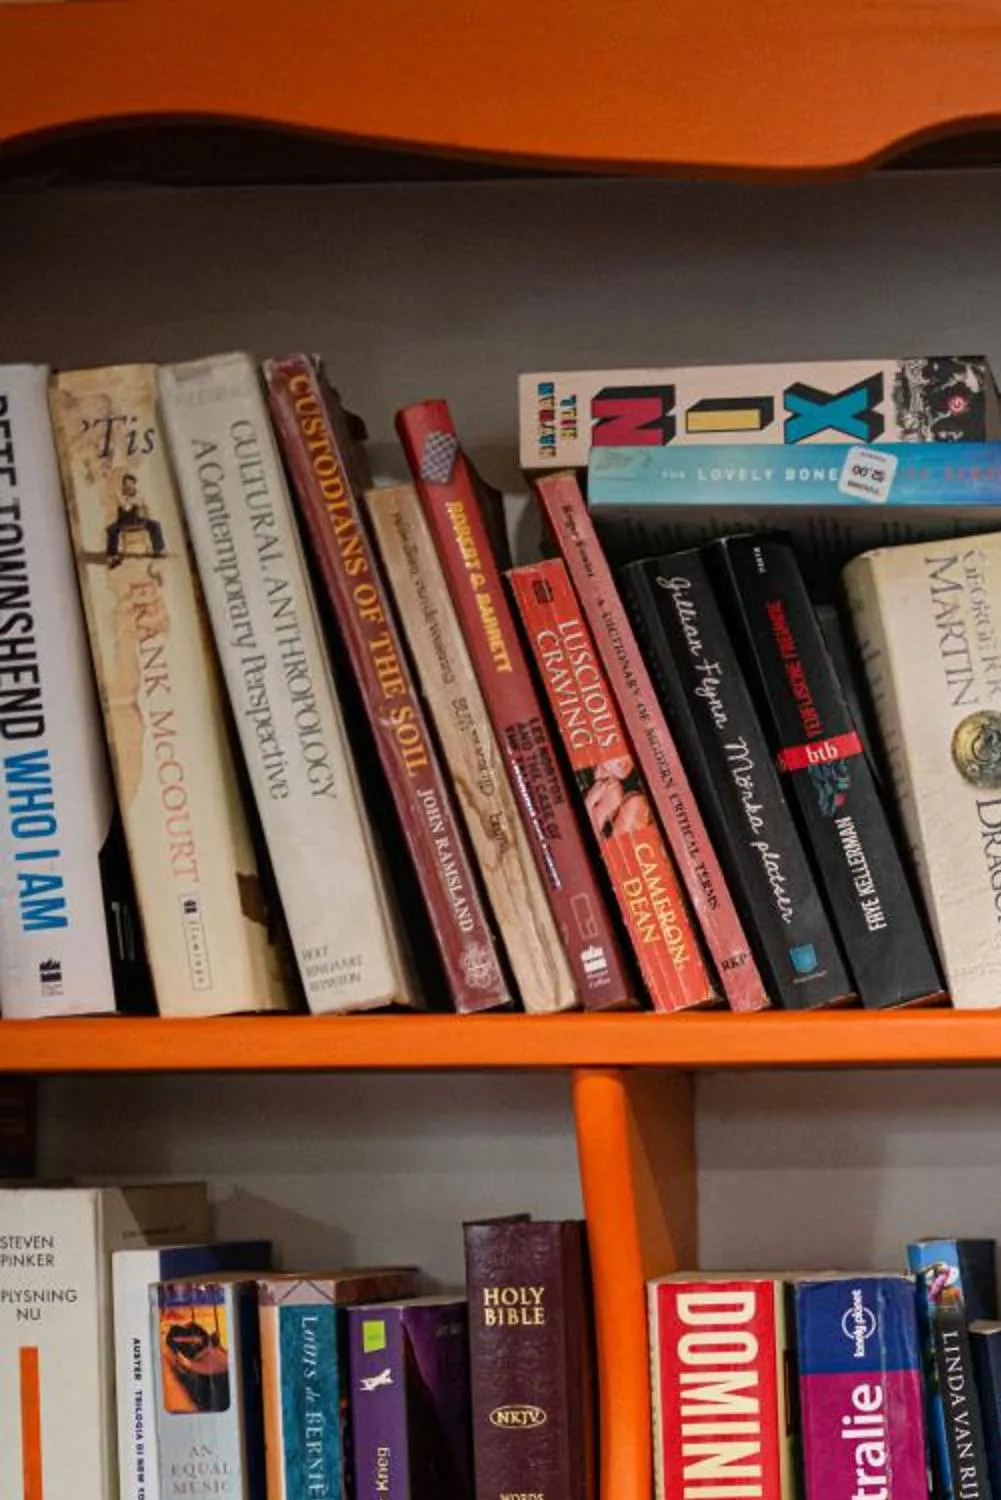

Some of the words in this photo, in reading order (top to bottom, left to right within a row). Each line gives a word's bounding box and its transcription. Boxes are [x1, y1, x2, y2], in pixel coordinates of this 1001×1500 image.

[191, 439, 218, 459] A
[697, 467, 773, 483] LOVELY
[199, 462, 256, 648] Contemporary
[288, 375, 369, 577] CUSTODIANS
[354, 583, 381, 625] OF
[368, 632, 405, 698] THE
[390, 703, 428, 778] SOIL
[129, 580, 170, 697] FRANK
[230, 420, 283, 570] CULTURAL
[266, 577, 337, 799] ANTHROPOLOGY
[925, 555, 979, 706] MARTIN
[241, 653, 289, 800] Perspective
[537, 631, 592, 750] CRAVING
[558, 619, 618, 747] LUSCIOUS
[3, 749, 57, 839] WHO
[693, 659, 729, 729] Flynn
[752, 840, 792, 924] platser
[805, 742, 839, 764] btb
[15, 849, 60, 861] I
[417, 787, 445, 841] JOHN
[435, 838, 475, 934] RAMSLAND
[17, 872, 68, 932] AM
[623, 877, 661, 943] DEAN
[635, 844, 690, 968] CAMERON
[0, 1234, 54, 1249] STEVEN
[1, 1255, 55, 1267] PINKER
[16, 1308, 41, 1321] NU
[483, 1287, 545, 1305] HOLY
[485, 1308, 545, 1326] BIBLE
[497, 1411, 540, 1425] NKJV
[942, 1330, 966, 1406] LINDA
[954, 1414, 975, 1459] VAN
